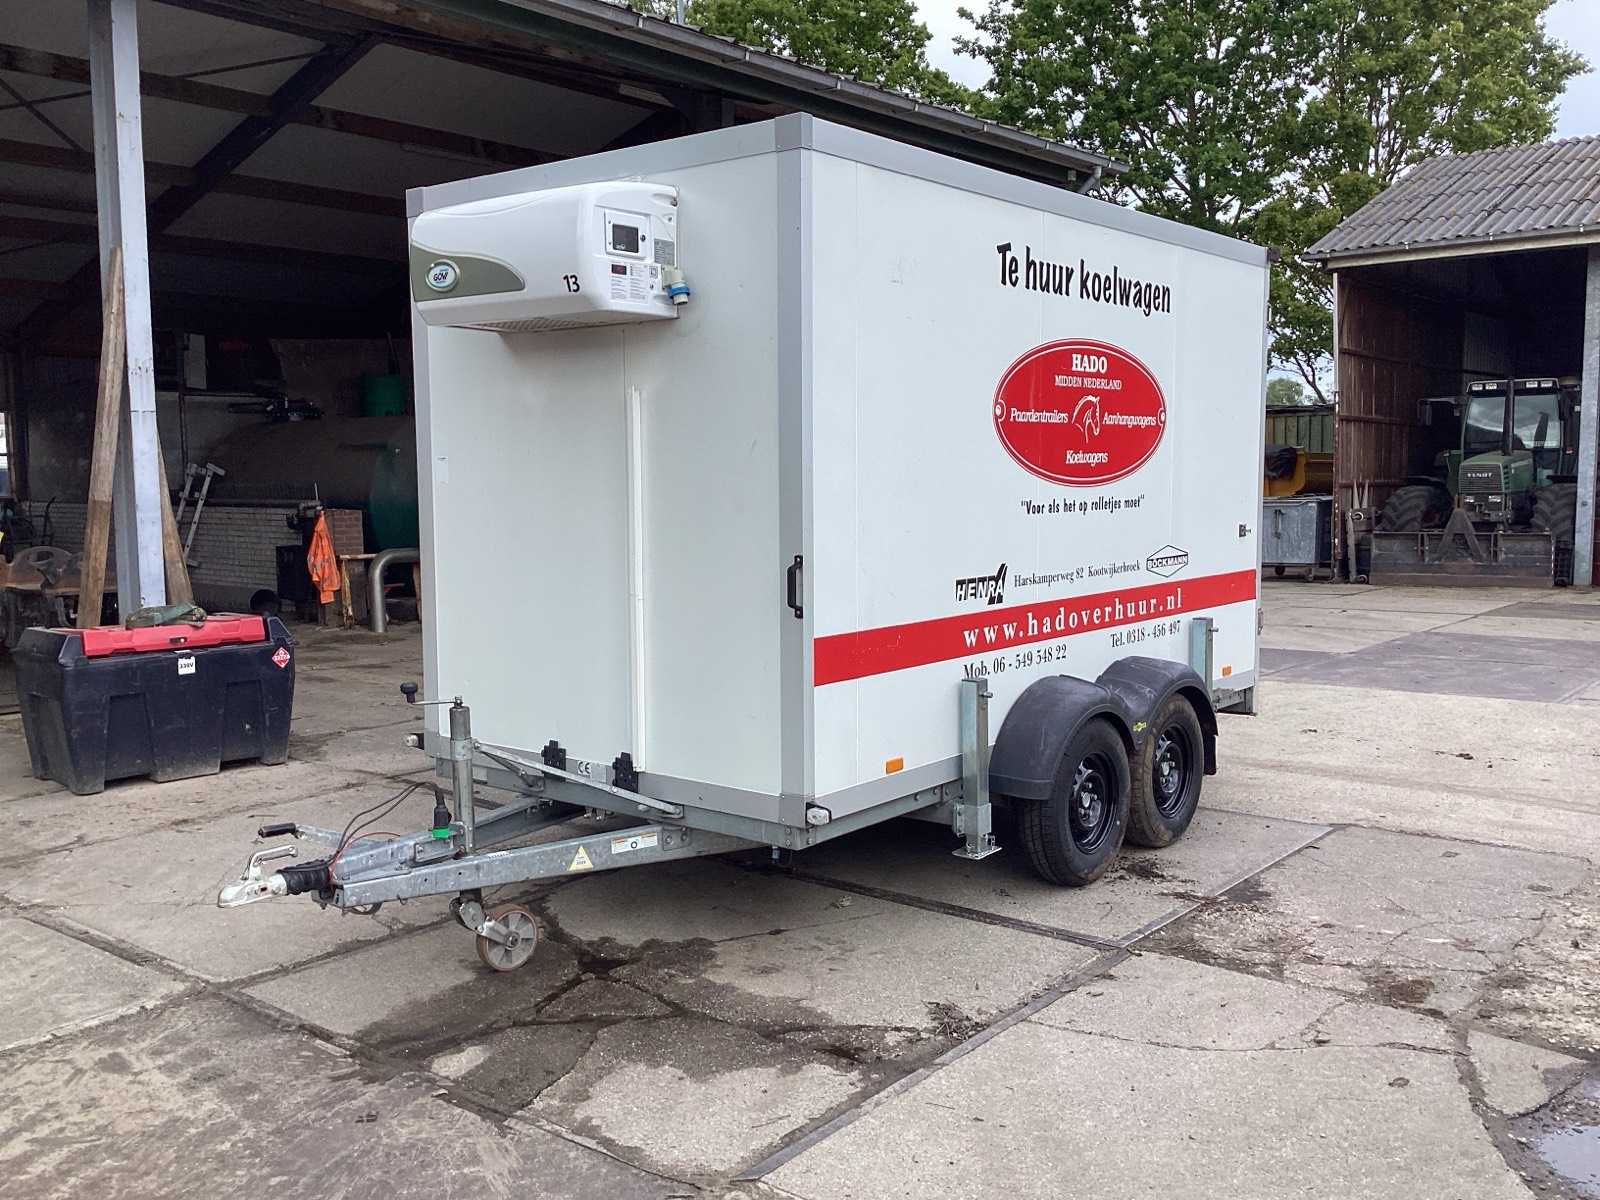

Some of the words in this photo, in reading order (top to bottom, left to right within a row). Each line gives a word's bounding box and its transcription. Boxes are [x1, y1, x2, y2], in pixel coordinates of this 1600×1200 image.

[563, 274, 580, 293] 13
[996, 242, 1020, 288] Te
[1024, 245, 1075, 297] huur
[1079, 258, 1171, 318] koelwagen
[1071, 353, 1108, 373] HADO
[1054, 375, 1082, 388] MIDDEN
[1082, 377, 1122, 391] NEDERLAND
[1009, 407, 1069, 424] Paardentrailers
[1065, 449, 1109, 467] Koelwagens
[1048, 498, 1060, 514] als
[1063, 498, 1076, 513] het
[1079, 500, 1088, 516] op
[1091, 496, 1122, 514] rolletjes
[956, 562, 1008, 605] HENRA
[1014, 571, 1075, 588] Harskamperweg
[1075, 567, 1085, 580] 82
[963, 587, 1183, 649] www.hadoverhuur.nl
[1110, 632, 1125, 648] Tel.
[1126, 627, 1146, 644] 0318
[1152, 622, 1167, 639] 456
[1168, 620, 1181, 635] 497
[963, 658, 990, 679] Mob.
[993, 655, 1006, 674] 06
[1015, 648, 1033, 669] 549
[1035, 644, 1053, 664] 548
[1055, 643, 1067, 661] 22
